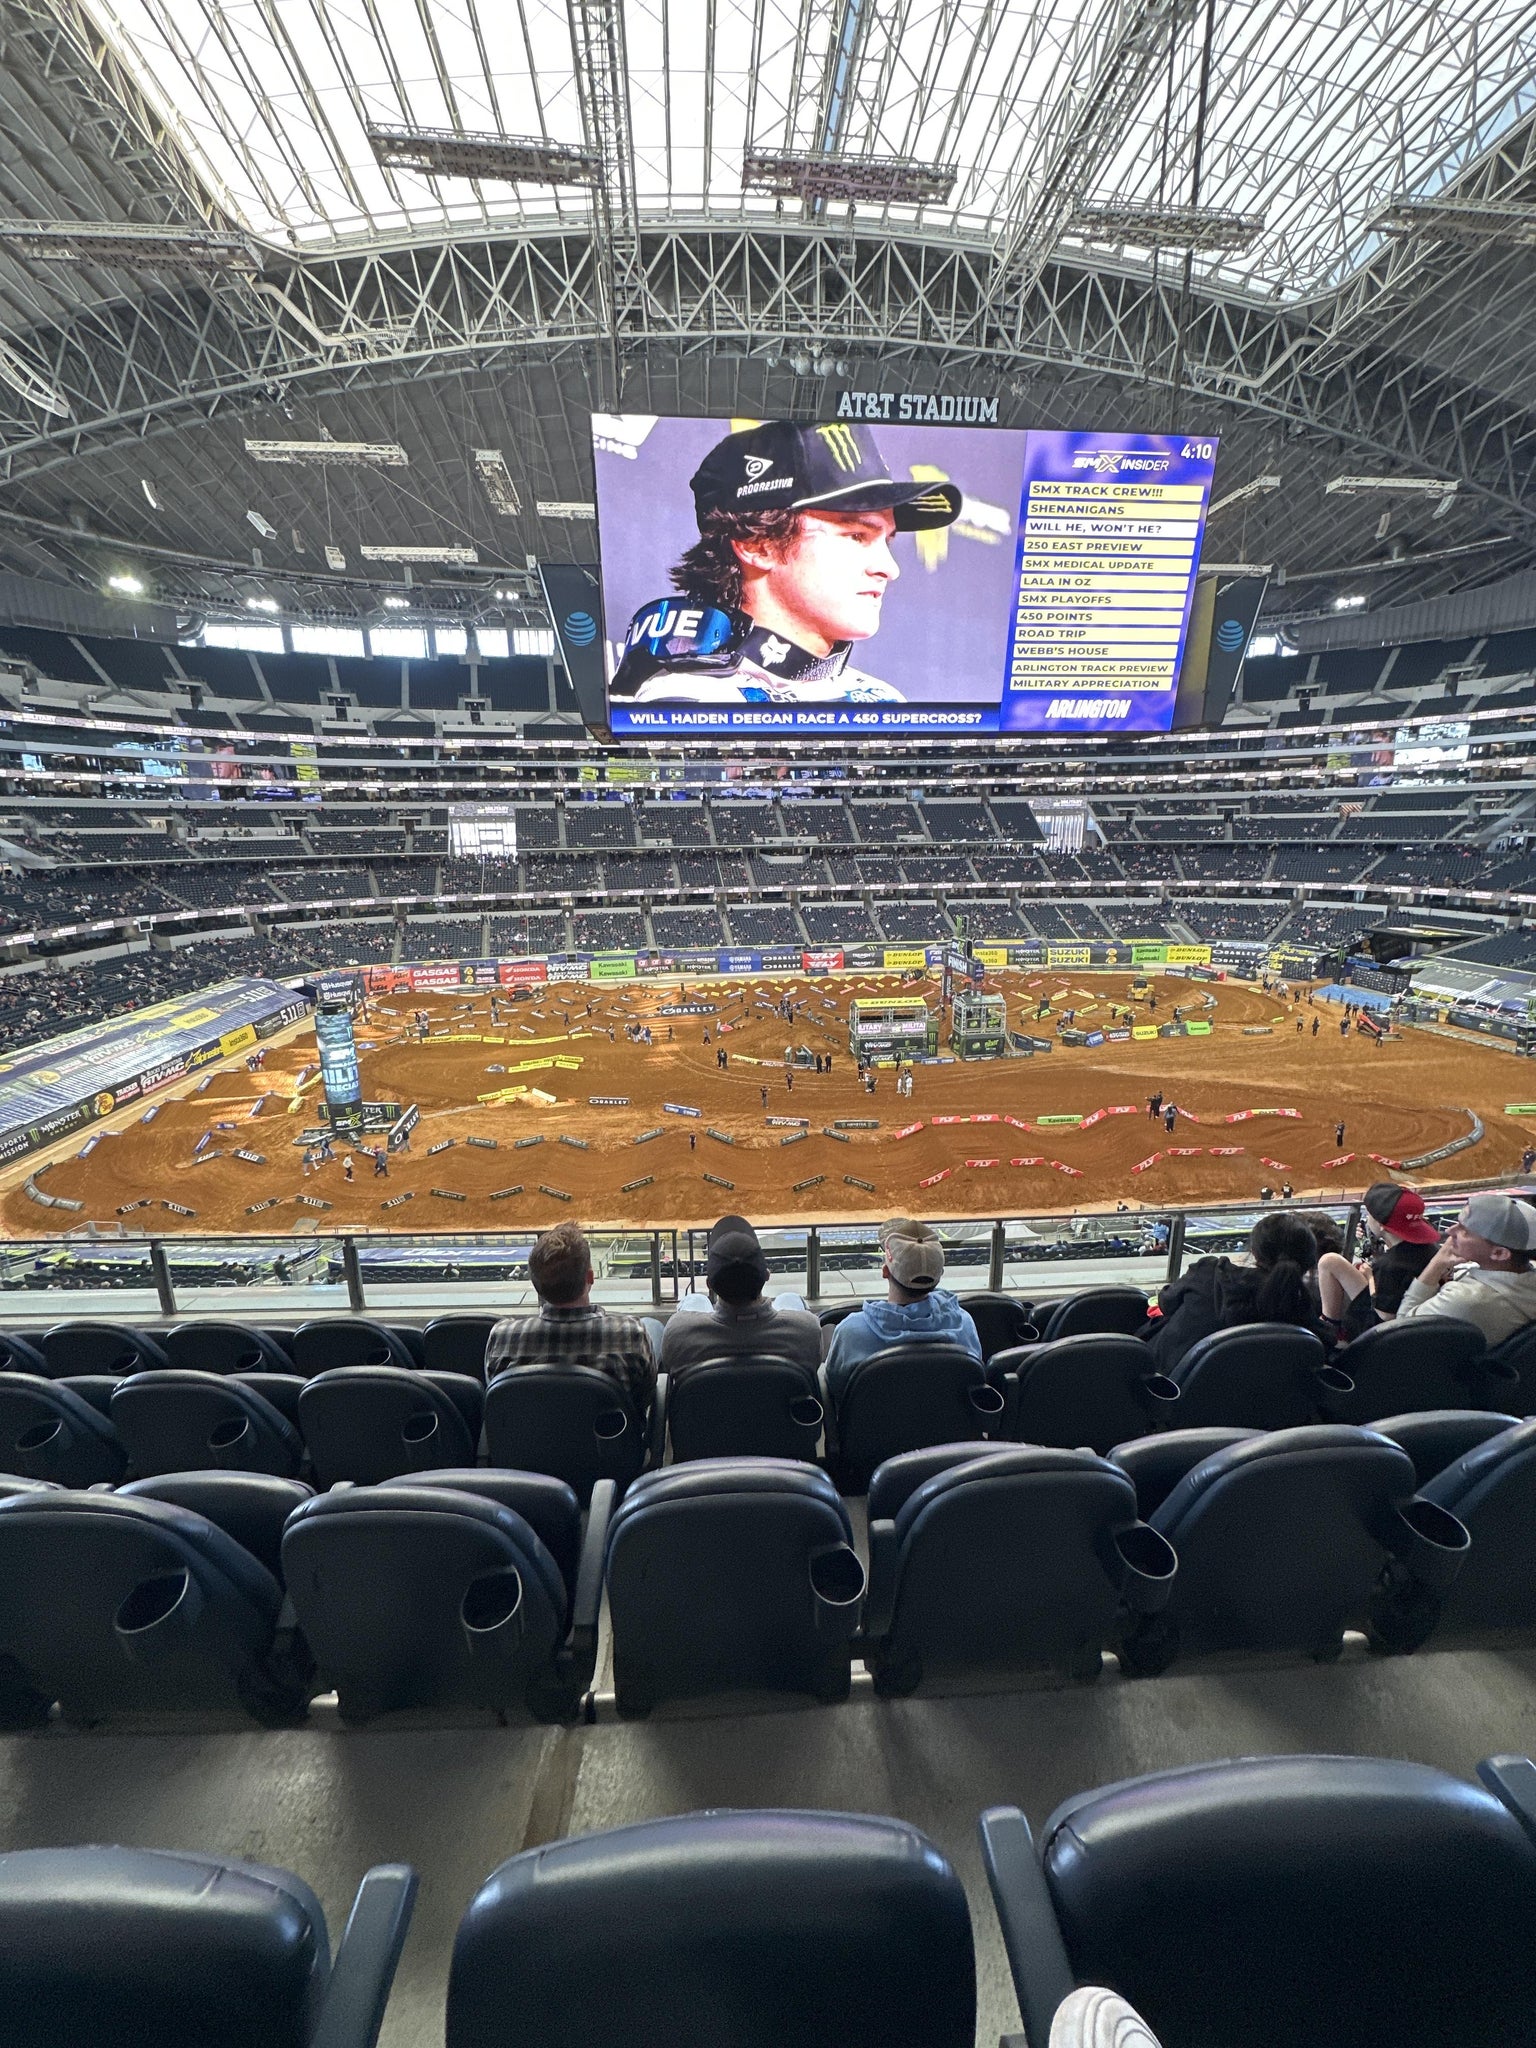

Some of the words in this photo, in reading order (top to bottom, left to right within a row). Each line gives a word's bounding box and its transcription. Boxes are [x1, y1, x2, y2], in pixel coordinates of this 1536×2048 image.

[837, 392, 894, 418] AT&T
[899, 394, 999, 422] STADIUM
[1181, 443, 1212, 460] 4:10
[1121, 458, 1169, 471] INSIDER
[1032, 485, 1061, 494] SMX
[1066, 486, 1108, 496] TRACK
[1112, 488, 1163, 497] CREW!!!
[1031, 504, 1125, 515] SHENANIGANS
[1030, 522, 1063, 531] WILL
[1066, 523, 1086, 533] HE,
[1091, 524, 1135, 533] WON'T
[1138, 525, 1161, 533] HE?
[1027, 541, 1048, 550] 250
[1052, 542, 1083, 550] EAST
[1086, 543, 1143, 551] PREVIEW
[1054, 560, 1105, 569] MEDICAL
[1109, 561, 1154, 570] UPDATE
[1024, 578, 1054, 586] LALA
[1059, 578, 1071, 586] IN
[1021, 595, 1047, 603] SMX
[1051, 596, 1112, 604] PLAYOFFS
[1047, 613, 1093, 621] POINTS
[1058, 630, 1086, 638] TRIP
[1017, 647, 1065, 655] WEBB'S
[1072, 680, 1160, 688] APPRECIATION
[1045, 700, 1132, 718] ARLINGTON
[630, 713, 668, 724] WILL
[671, 713, 728, 724] HAIDEN
[732, 713, 794, 724] DEEGAN
[797, 713, 835, 724] RACE
[838, 713, 849, 724] A
[852, 713, 879, 724] 450
[882, 713, 982, 724] SUPERCROSS?
[948, 955, 967, 974] FINISH
[412, 968, 457, 977] GASGAS
[414, 977, 458, 986] GASGAS
[280, 1006, 297, 1026] 5.11
[41, 1110, 82, 1133] MONSTER
[939, 1115, 956, 1123] FLY
[976, 1114, 993, 1122] FLY
[1047, 1116, 1075, 1124] Kawasaki
[1084, 1114, 1099, 1125] FLY
[1011, 1119, 1026, 1129] FLY
[899, 1126, 916, 1136] FLY
[974, 1159, 992, 1167] FLY
[1019, 1158, 1038, 1166] FLY
[1138, 1157, 1155, 1169] FLY
[1269, 1160, 1285, 1170] FLY
[1332, 1156, 1349, 1166] FLY
[1378, 1157, 1395, 1167] FLY
[1060, 1165, 1078, 1175] FLY
[928, 1173, 944, 1184] FLY
[302, 1197, 316, 1206] 5.11
[122, 1202, 134, 1212] 5.11
[168, 1203, 182, 1213] 5.11
[251, 1202, 265, 1212] 5.11
